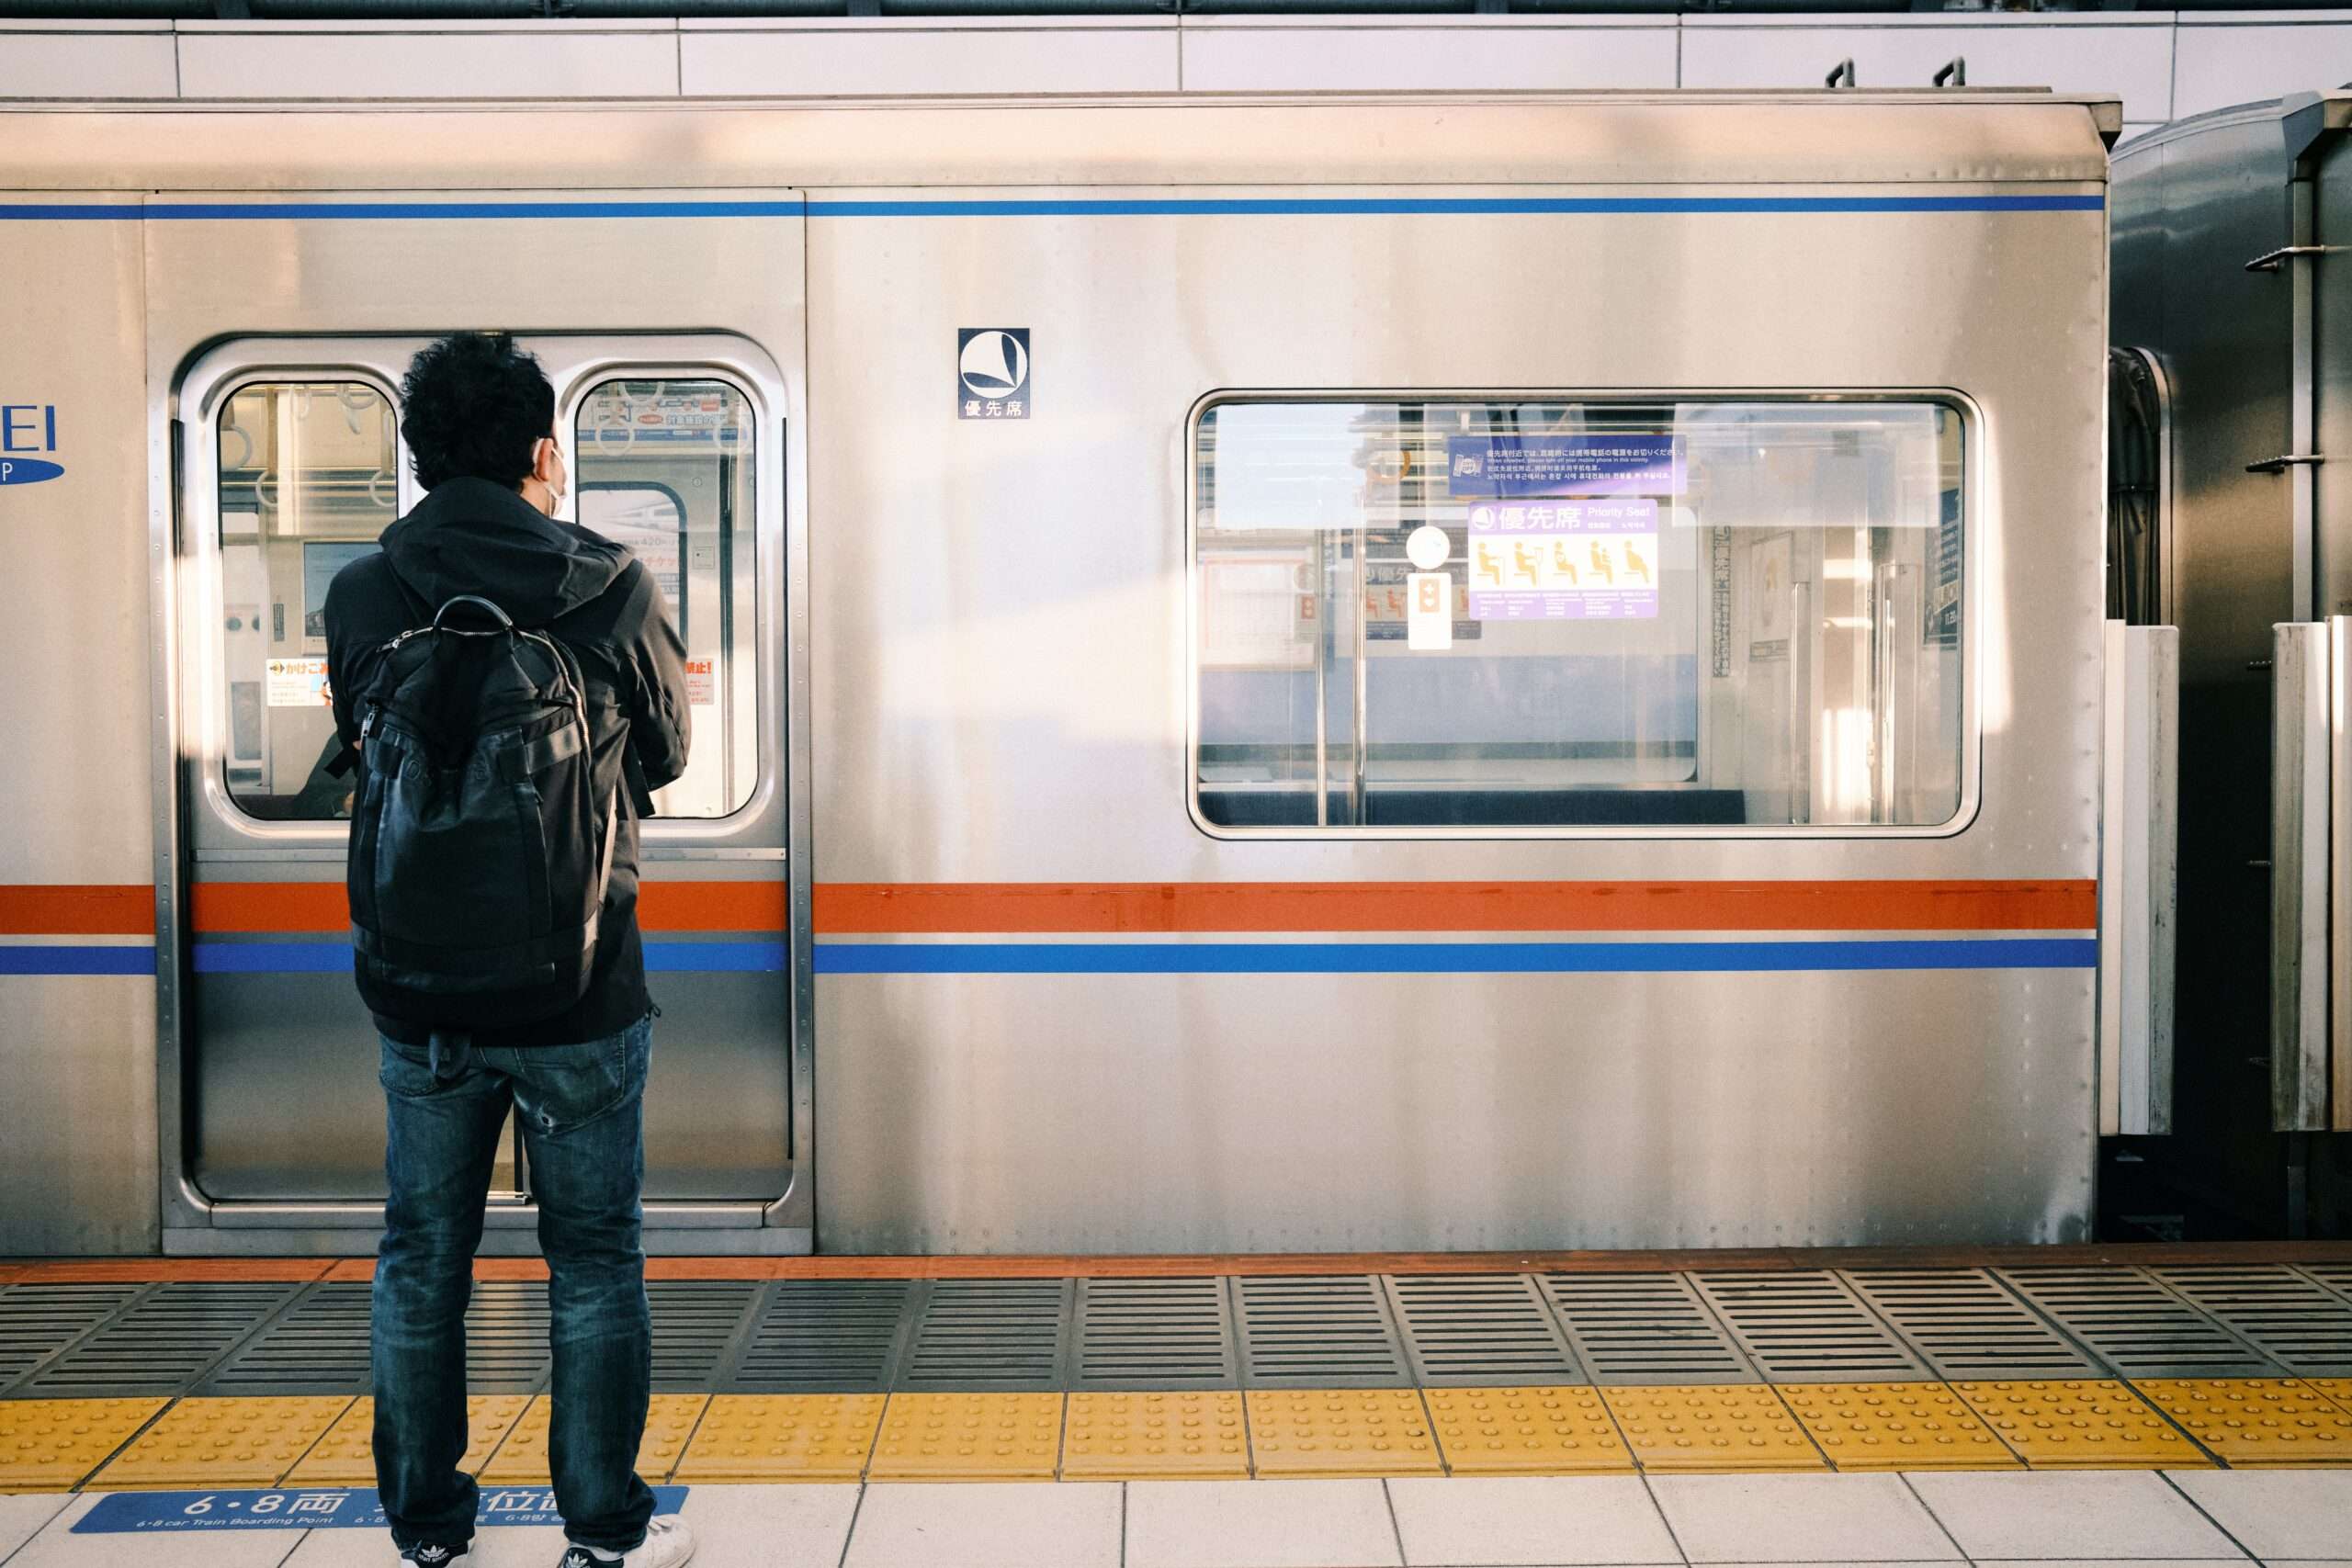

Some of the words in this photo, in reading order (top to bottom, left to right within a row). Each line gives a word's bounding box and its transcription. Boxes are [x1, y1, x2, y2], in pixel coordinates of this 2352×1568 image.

[965, 400, 1023, 417] 優先席
[1499, 506, 1582, 530] 優先席
[1588, 506, 1623, 519] Priority
[1626, 506, 1651, 517] Seat
